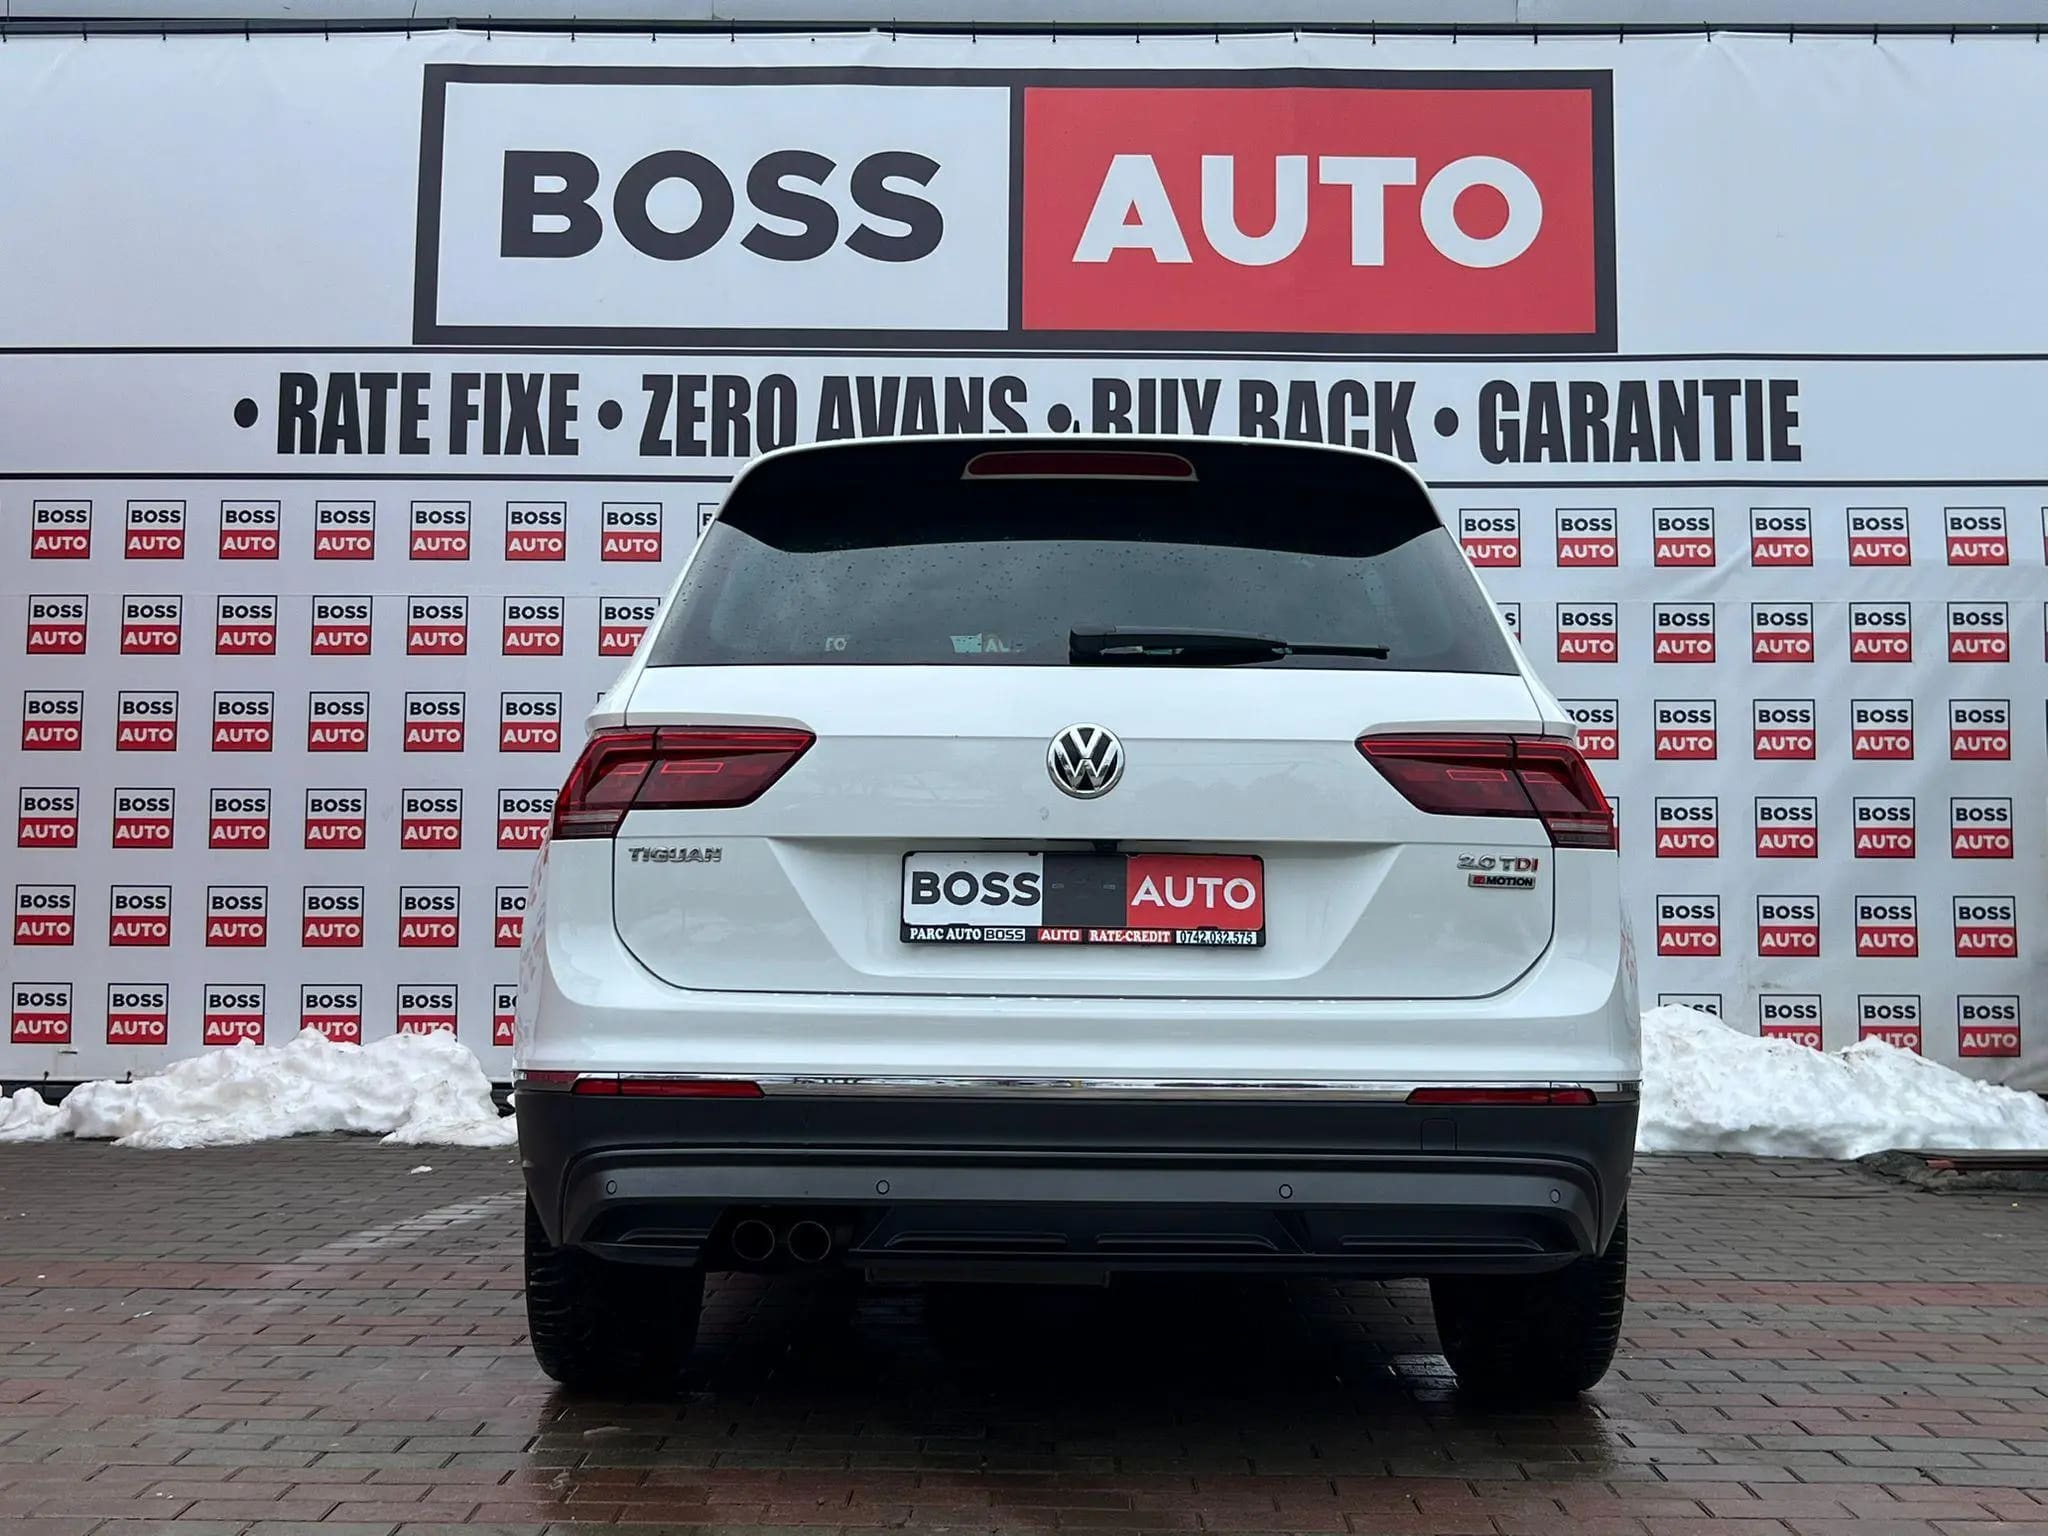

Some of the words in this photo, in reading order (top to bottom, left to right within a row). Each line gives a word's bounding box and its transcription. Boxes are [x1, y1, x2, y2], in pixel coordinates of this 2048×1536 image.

[500, 149, 944, 262] BOSS
[1072, 153, 1544, 269] AUTO
[276, 372, 431, 455] RATE
[449, 373, 580, 456] FIXE
[638, 374, 797, 458] ZERO
[815, 374, 1030, 437] AVANS
[1092, 378, 1222, 434] BUY
[1237, 379, 1418, 463] BACK
[1478, 379, 1802, 464] GARANTIE
[37, 510, 87, 524] BOSS
[131, 510, 181, 524] BOSS
[225, 510, 275, 524] BOSS
[320, 511, 371, 524] BOSS
[415, 511, 466, 525] BOSS
[511, 512, 562, 525] BOSS
[607, 513, 658, 526] BOSS
[1658, 518, 1710, 531] BOSS
[1755, 518, 1807, 531] BOSS
[1852, 518, 1905, 531] BOSS
[1950, 518, 2002, 530] BOSS
[1464, 518, 1516, 532] BOSS
[1561, 519, 1613, 532] BOSS
[34, 536, 88, 550] AUTO
[128, 536, 182, 550] AUTO
[222, 536, 276, 551] AUTO
[317, 536, 372, 551] AUTO
[412, 537, 467, 552] AUTO
[508, 537, 563, 552] AUTO
[604, 538, 659, 553] AUTO
[1754, 543, 1810, 558] AUTO
[1852, 543, 1908, 558] AUTO
[1950, 542, 2006, 558] AUTO
[1464, 544, 1518, 559] AUTO
[1560, 543, 1616, 559] AUTO
[1657, 543, 1713, 559] AUTO
[33, 605, 82, 619] BOSS
[126, 605, 177, 619] BOSS
[221, 606, 273, 619] BOSS
[317, 606, 368, 619] BOSS
[412, 606, 464, 619] BOSS
[508, 606, 560, 620] BOSS
[604, 606, 655, 620] BOSS
[1756, 613, 1809, 626] BOSS
[1854, 613, 1907, 626] BOSS
[1952, 612, 2004, 626] BOSS
[1562, 613, 1613, 627] BOSS
[1658, 613, 1711, 627] BOSS
[30, 631, 83, 645] AUTO
[123, 631, 178, 646] AUTO
[218, 631, 273, 646] AUTO
[314, 632, 369, 646] AUTO
[409, 632, 463, 647] AUTO
[505, 632, 561, 647] AUTO
[601, 633, 642, 648] AUT
[1560, 639, 1615, 654] AUTO
[1657, 639, 1713, 654] AUTO
[1756, 639, 1811, 654] AUTO
[1853, 638, 1909, 654] AUTO
[1952, 638, 2007, 654] AUTO
[28, 701, 78, 715] BOSS
[122, 701, 174, 715] BOSS
[218, 702, 269, 716] BOSS
[314, 702, 365, 716] BOSS
[409, 702, 461, 716] BOSS
[506, 703, 557, 716] BOSS
[1659, 710, 1712, 724] BOSS
[1759, 710, 1811, 723] BOSS
[1856, 710, 1909, 723] BOSS
[1955, 710, 2006, 724] BOSS
[25, 727, 79, 742] AUTO
[119, 727, 174, 742] AUTO
[215, 728, 270, 743] AUTO
[311, 728, 365, 743] AUTO
[407, 728, 461, 743] AUTO
[503, 728, 558, 743] AUTO
[1576, 735, 1616, 751] UTO
[1657, 736, 1714, 751] AUTO
[1757, 736, 1813, 751] AUTO
[1855, 736, 1911, 751] AUTO
[1953, 736, 2007, 751] AUTO
[24, 798, 74, 812] BOSS
[118, 798, 170, 812] BOSS
[215, 799, 266, 813] BOSS
[310, 799, 362, 813] BOSS
[406, 799, 458, 813] BOSS
[503, 798, 554, 813] BOSS
[1660, 808, 1714, 821] BOSS
[1761, 807, 1813, 821] BOSS
[1858, 808, 1911, 822] BOSS
[1955, 808, 2008, 822] BOSS
[21, 824, 75, 839] AUTO
[116, 825, 170, 839] AUTO
[211, 825, 266, 840] AUTO
[307, 825, 363, 840] AUTO
[404, 825, 458, 840] AUTO
[1658, 834, 1716, 849] AUTO
[1759, 834, 1815, 849] AUTO
[1857, 834, 1913, 849] AUTO
[1955, 835, 2010, 850] AUTO
[628, 846, 723, 863] TIGUAN
[1499, 855, 1539, 873] TDI
[911, 871, 1041, 906] BOSS
[1131, 875, 1256, 909] AUTO
[20, 895, 70, 909] BOSS
[115, 896, 167, 910] BOSS
[211, 896, 263, 910] BOSS
[308, 897, 360, 911] BOSS
[405, 897, 455, 911] BOSS
[500, 896, 527, 911] BO
[1662, 906, 1716, 919] BOSS
[1763, 906, 1815, 920] BOSS
[1860, 906, 1913, 920] BOSS
[1960, 907, 2012, 921] BOSS
[17, 921, 71, 936] AUTO
[112, 922, 167, 937] AUTO
[208, 923, 264, 938] AUTO
[305, 923, 360, 938] AUTO
[402, 923, 456, 938] AUTO
[909, 927, 944, 941] PARC
[945, 928, 982, 941] AUTO
[985, 929, 1025, 941] BOSS
[1041, 929, 1080, 942] AUTO
[1660, 932, 1718, 947] AUTO
[1761, 932, 1817, 948] AUTO
[1859, 933, 1915, 948] AUTO
[1958, 933, 2014, 948] AUTO
[17, 993, 68, 1007] BOSS
[112, 994, 164, 1008] BOSS
[209, 995, 261, 1009] BOSS
[305, 994, 358, 1009] BOSS
[402, 994, 453, 1009] BOSS
[1764, 1004, 1817, 1019] BOSS
[1863, 1004, 1917, 1019] BOSS
[1964, 1006, 2015, 1020] BOSS
[14, 1020, 68, 1035] AUTO
[109, 1020, 165, 1035] AUTO
[206, 1021, 261, 1036] AUTO
[1962, 1033, 2017, 1048] AUTO
